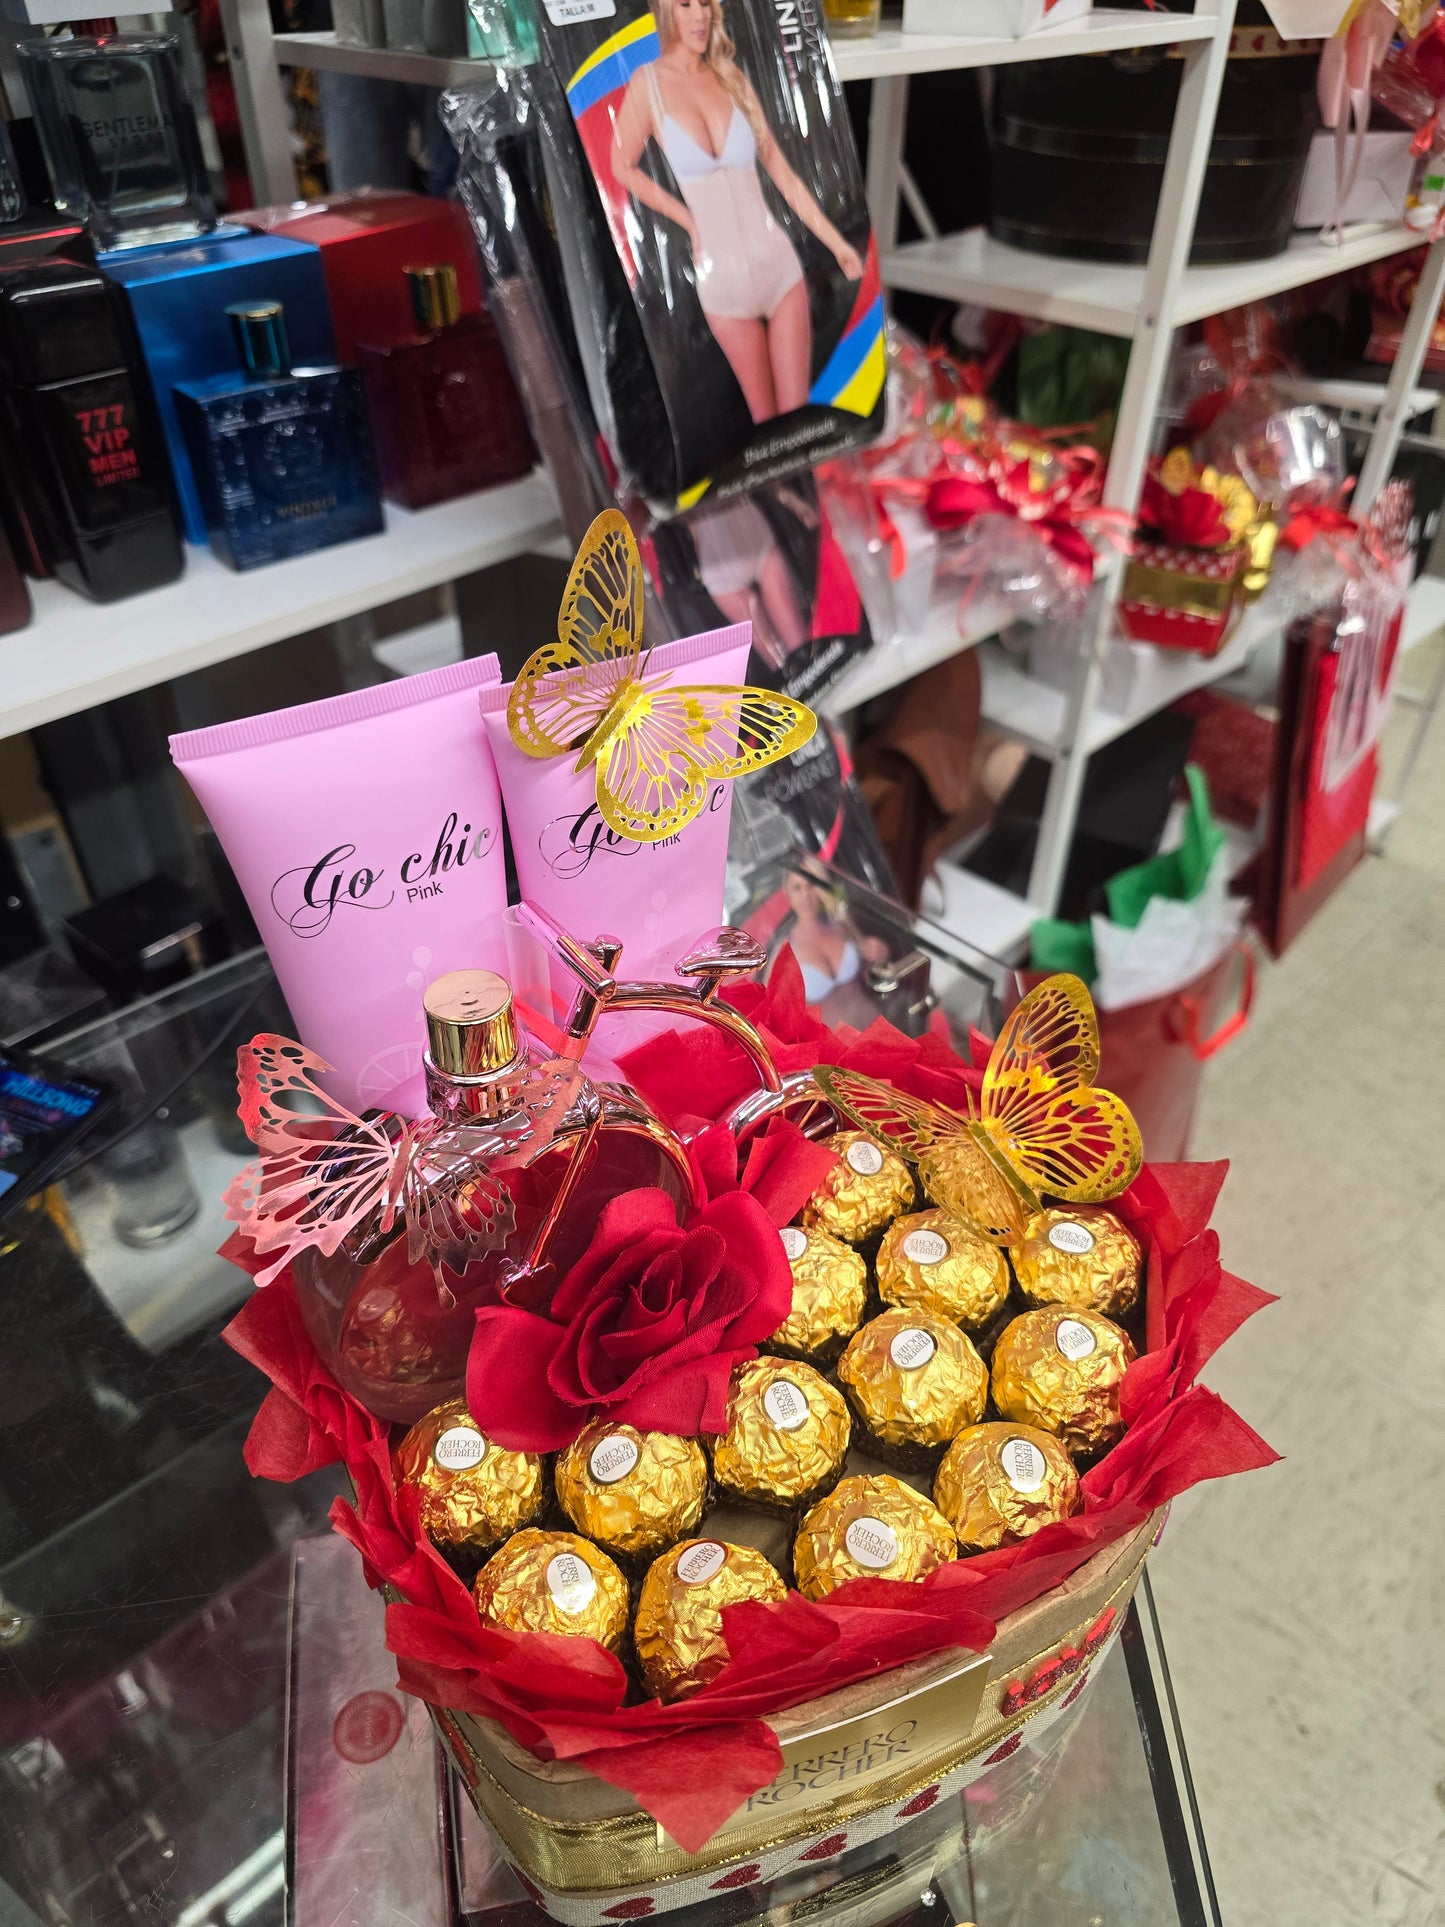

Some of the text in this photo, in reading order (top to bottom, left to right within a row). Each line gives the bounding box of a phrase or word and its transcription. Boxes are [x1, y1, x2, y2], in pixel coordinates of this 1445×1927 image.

[774, 0, 803, 53] LIN
[75, 403, 124, 433] 777
[83, 427, 130, 454] VIP
[89, 448, 137, 474] MEN
[652, 833, 682, 851] Pink
[271, 812, 499, 939] Go chic
[406, 881, 444, 904] Pink
[906, 1244, 943, 1256] FERRERO
[908, 1237, 944, 1250] ROCHER
[896, 1332, 925, 1359] ROCHER
[901, 1336, 931, 1365] FERRERO
[771, 1386, 791, 1420] ROCHE
[779, 1383, 798, 1417] FERRER
[438, 1448, 481, 1458] FERRERO
[440, 1440, 481, 1449] ROCHER
[593, 1442, 632, 1468] ROCHER
[597, 1448, 636, 1477] FERRERO
[848, 1534, 892, 1562] FERRERO
[853, 1524, 895, 1553] ROCHER
[681, 1543, 713, 1577] FERRERO
[688, 1547, 721, 1581] ROCHER
[771, 1719, 919, 1789] ERRERO
[747, 1740, 913, 1812] ROCHER
